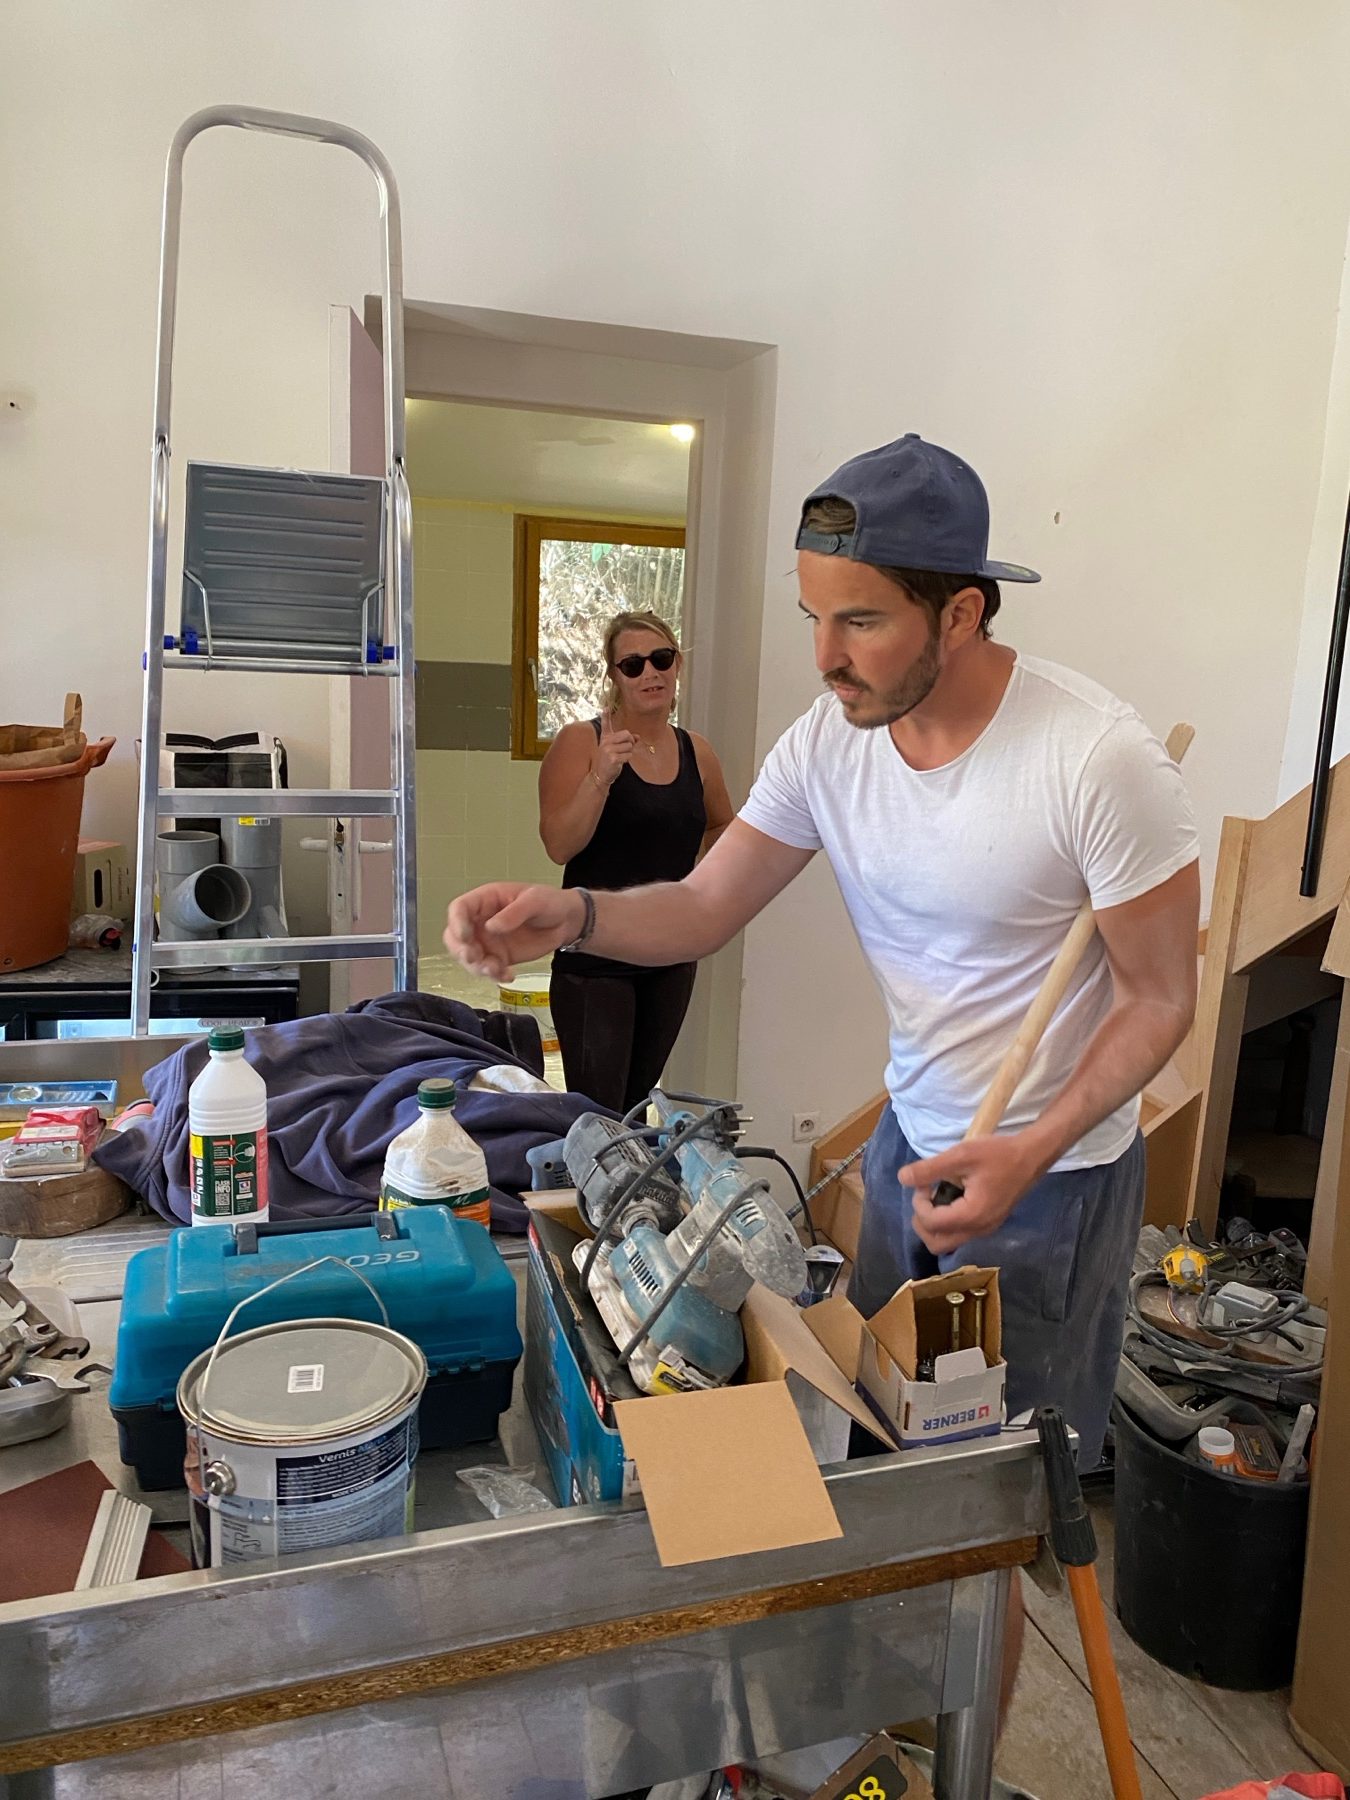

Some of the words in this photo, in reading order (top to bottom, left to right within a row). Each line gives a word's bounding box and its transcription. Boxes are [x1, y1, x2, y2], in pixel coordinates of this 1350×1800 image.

[345, 1250, 420, 1268] GEO
[923, 1409, 976, 1430] BERNER
[318, 1447, 356, 1463] Vernis
